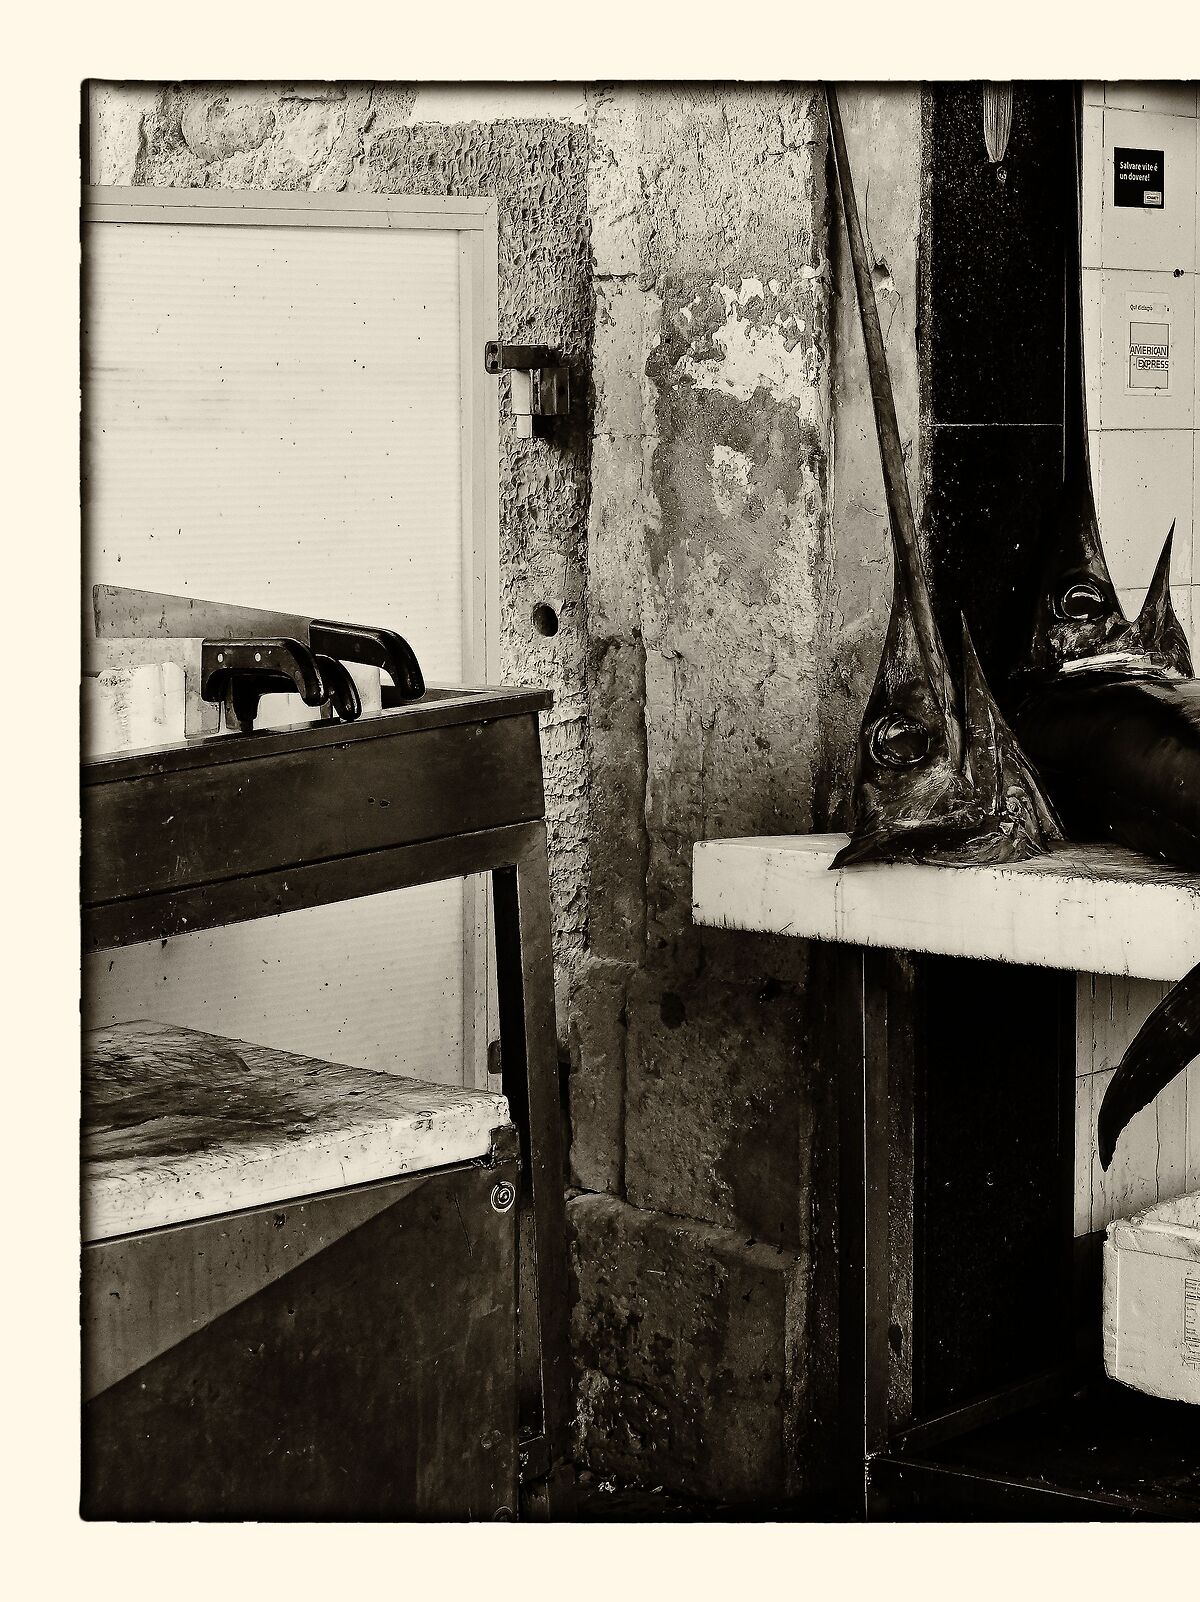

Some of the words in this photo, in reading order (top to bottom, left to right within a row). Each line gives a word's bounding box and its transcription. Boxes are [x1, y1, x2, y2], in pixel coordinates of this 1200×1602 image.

[1119, 161, 1142, 170] Salvare
[1142, 162, 1154, 171] vite
[1128, 172, 1150, 181] dovere!
[1130, 345, 1166, 356] AMERICAN
[1138, 359, 1169, 369] EXPRESS
